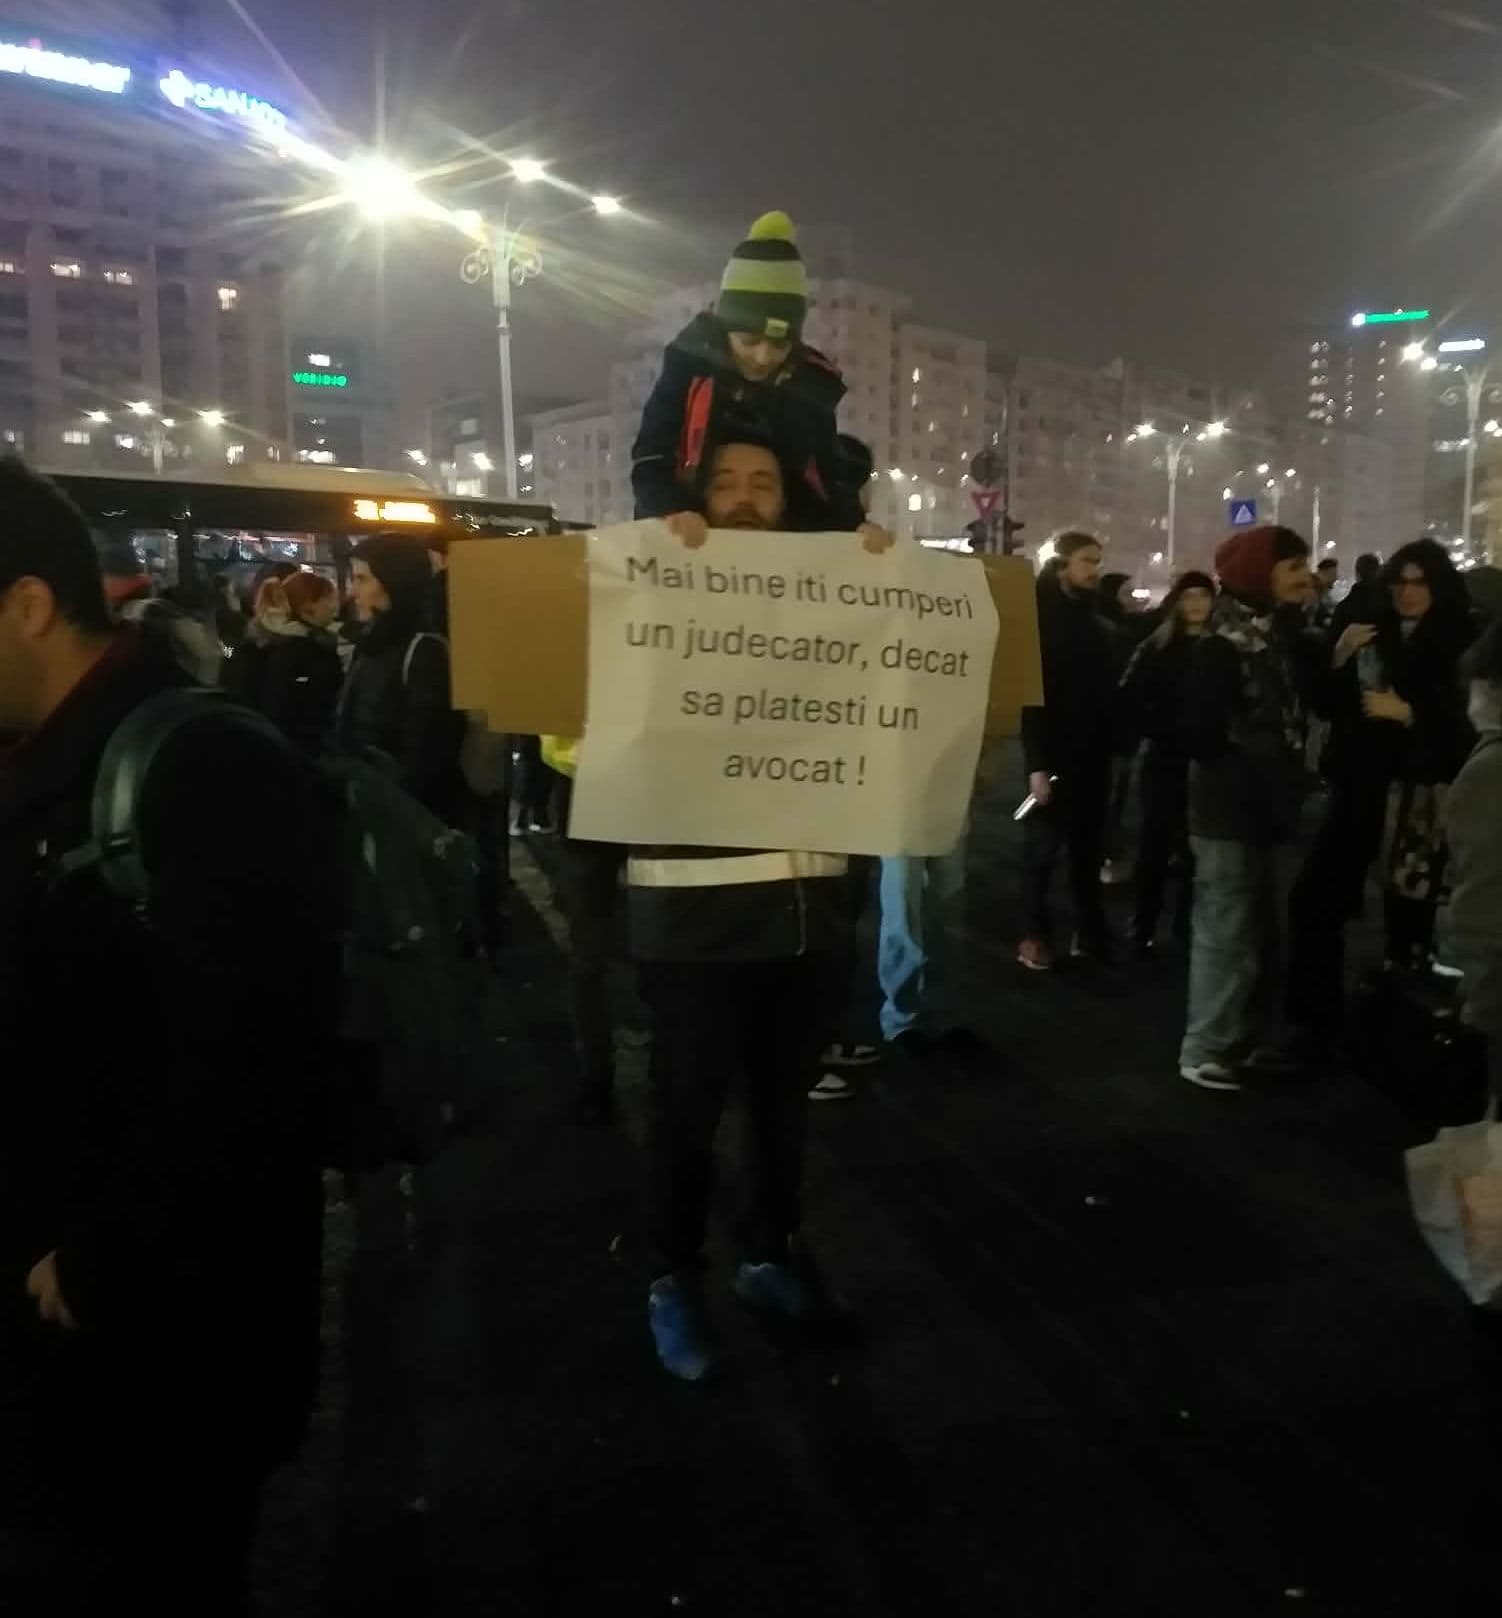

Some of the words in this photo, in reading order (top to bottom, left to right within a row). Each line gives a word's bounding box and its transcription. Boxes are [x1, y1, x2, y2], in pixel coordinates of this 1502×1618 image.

[625, 556, 694, 591] Mai
[705, 566, 787, 599] bine
[796, 569, 828, 603] iti
[837, 584, 975, 620] cumperi
[626, 622, 675, 650] un
[682, 619, 869, 673] judecator,
[880, 639, 970, 678] decat
[681, 690, 724, 717] sa
[734, 689, 867, 727] platesti
[878, 705, 920, 730] un
[723, 754, 847, 785] avocat
[857, 755, 866, 786] !
